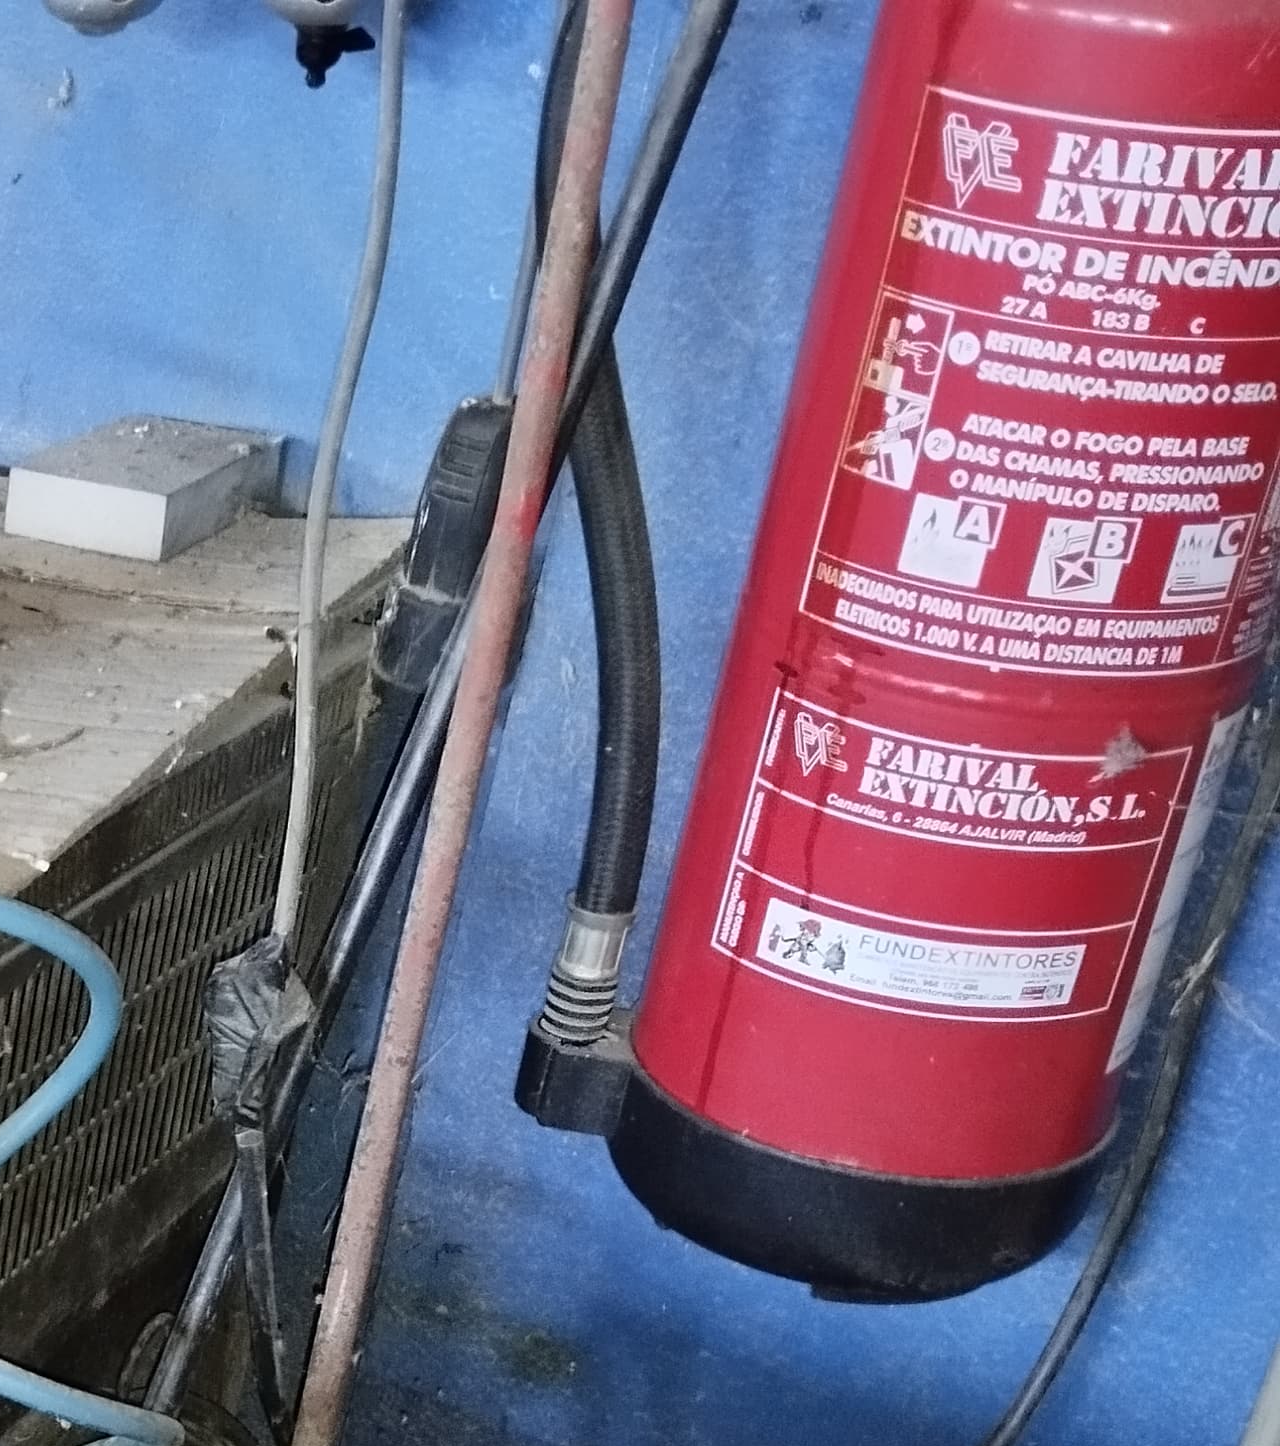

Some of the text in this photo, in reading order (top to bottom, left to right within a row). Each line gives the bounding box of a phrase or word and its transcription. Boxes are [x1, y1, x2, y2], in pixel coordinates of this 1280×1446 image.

[901, 210, 1067, 274] EXTINTOR
[1073, 247, 1130, 281] DE
[1022, 272, 1056, 295] PÓ
[1000, 296, 1207, 335] 27 A 183 B C
[985, 329, 1226, 375] RETIRAR A CAVILHA DE
[1212, 384, 1230, 404] O
[962, 413, 1250, 458] ATACAR O FOGO PELA BASE
[956, 440, 1265, 485] DAS CHAMAS, PRESSIONANDO
[949, 468, 1221, 513] O MANÍPULO DE DISPARO.
[957, 505, 992, 545] A
[1094, 522, 1128, 556] B
[1219, 520, 1245, 555] C
[816, 562, 918, 611] INADECUADOS
[918, 594, 963, 622] PARA
[1073, 618, 1102, 638] EM
[1103, 615, 1221, 640] EQUIPAMENTOS
[914, 622, 960, 649] 1.000
[979, 635, 995, 655] A
[998, 638, 1040, 662] UMA
[1135, 647, 1158, 666] DE
[1160, 645, 1184, 665] 1M
[864, 736, 1040, 792] FARIVAL
[826, 792, 888, 822] Canarias,
[957, 824, 1025, 842] AJALVIR
[859, 934, 1078, 970] FUNDEXTINTORES
